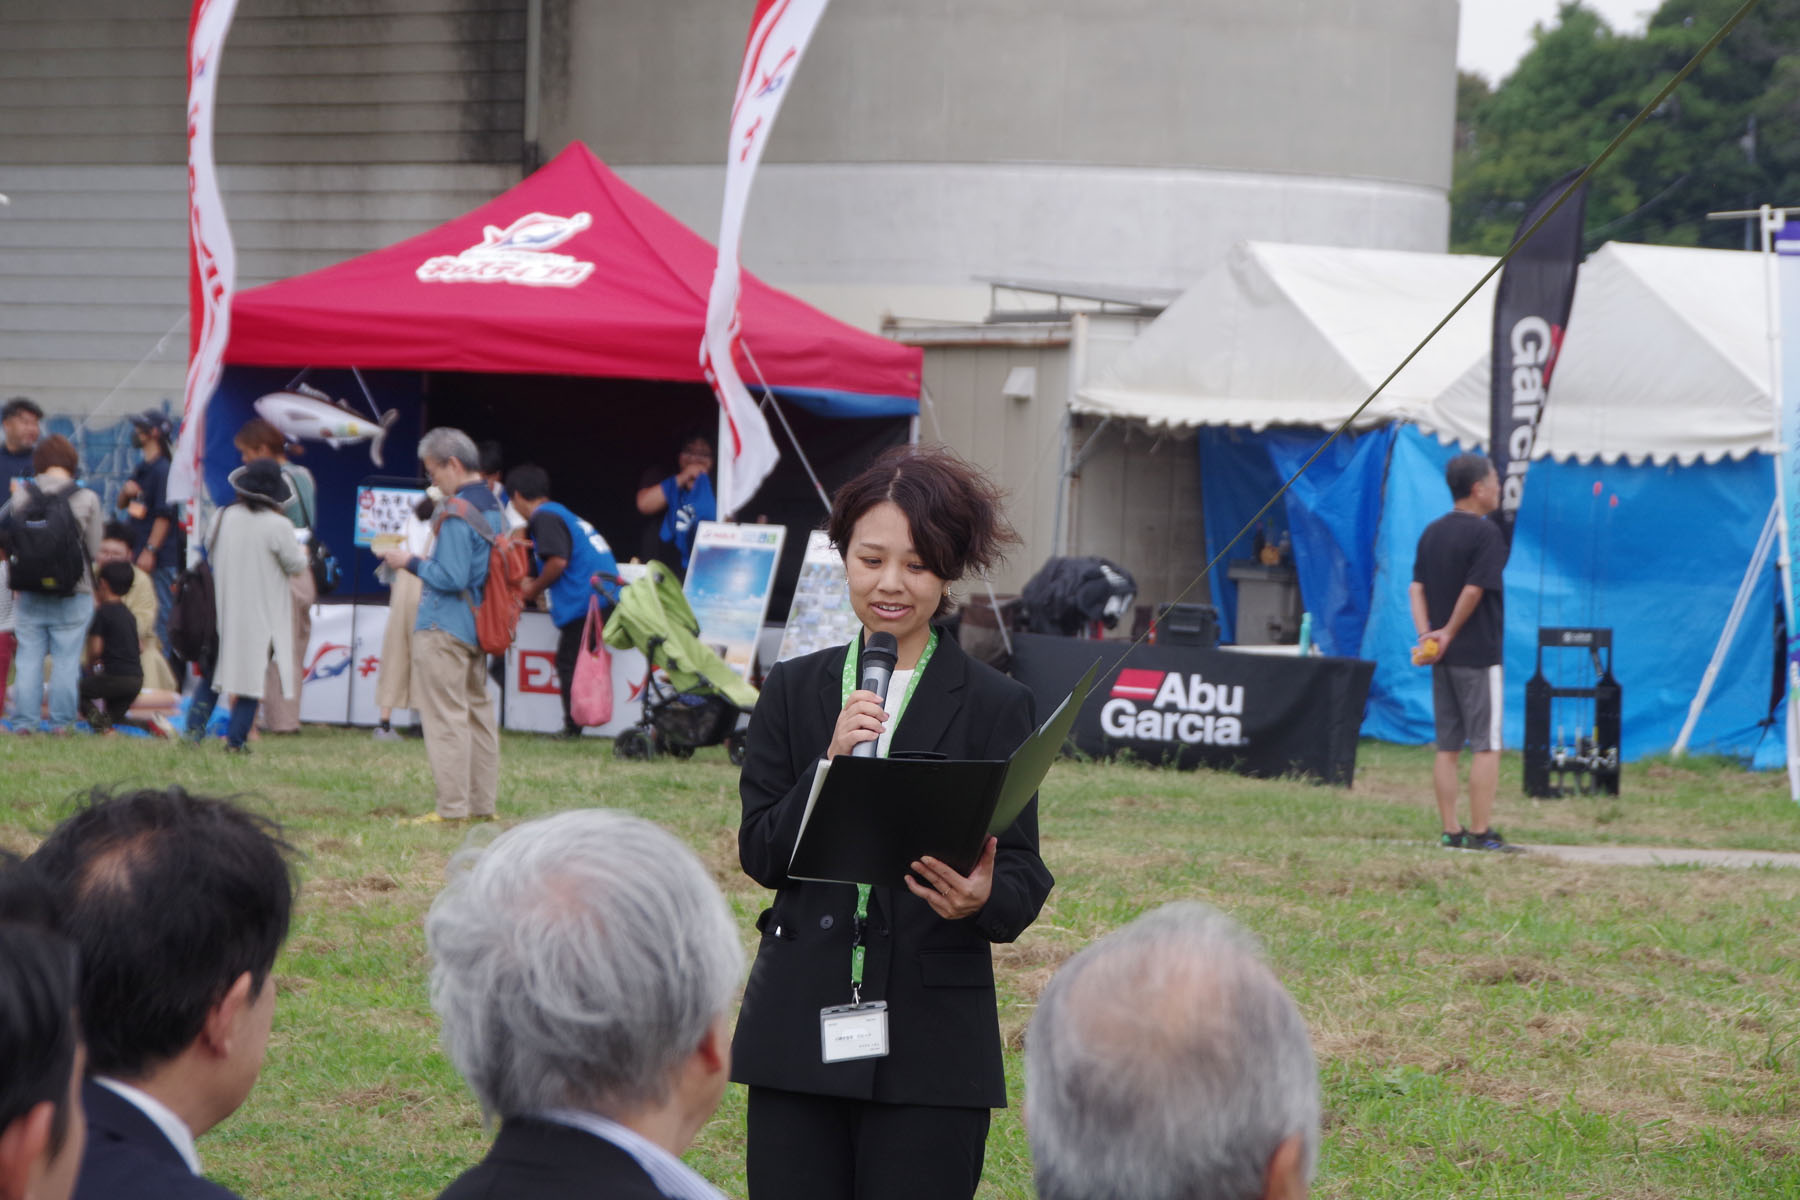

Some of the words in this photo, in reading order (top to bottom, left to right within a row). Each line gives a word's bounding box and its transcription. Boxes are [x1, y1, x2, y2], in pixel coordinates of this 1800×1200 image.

[1502, 315, 1551, 511] Garcia
[1153, 671, 1245, 715] Abu
[1100, 698, 1243, 746] Garcia
